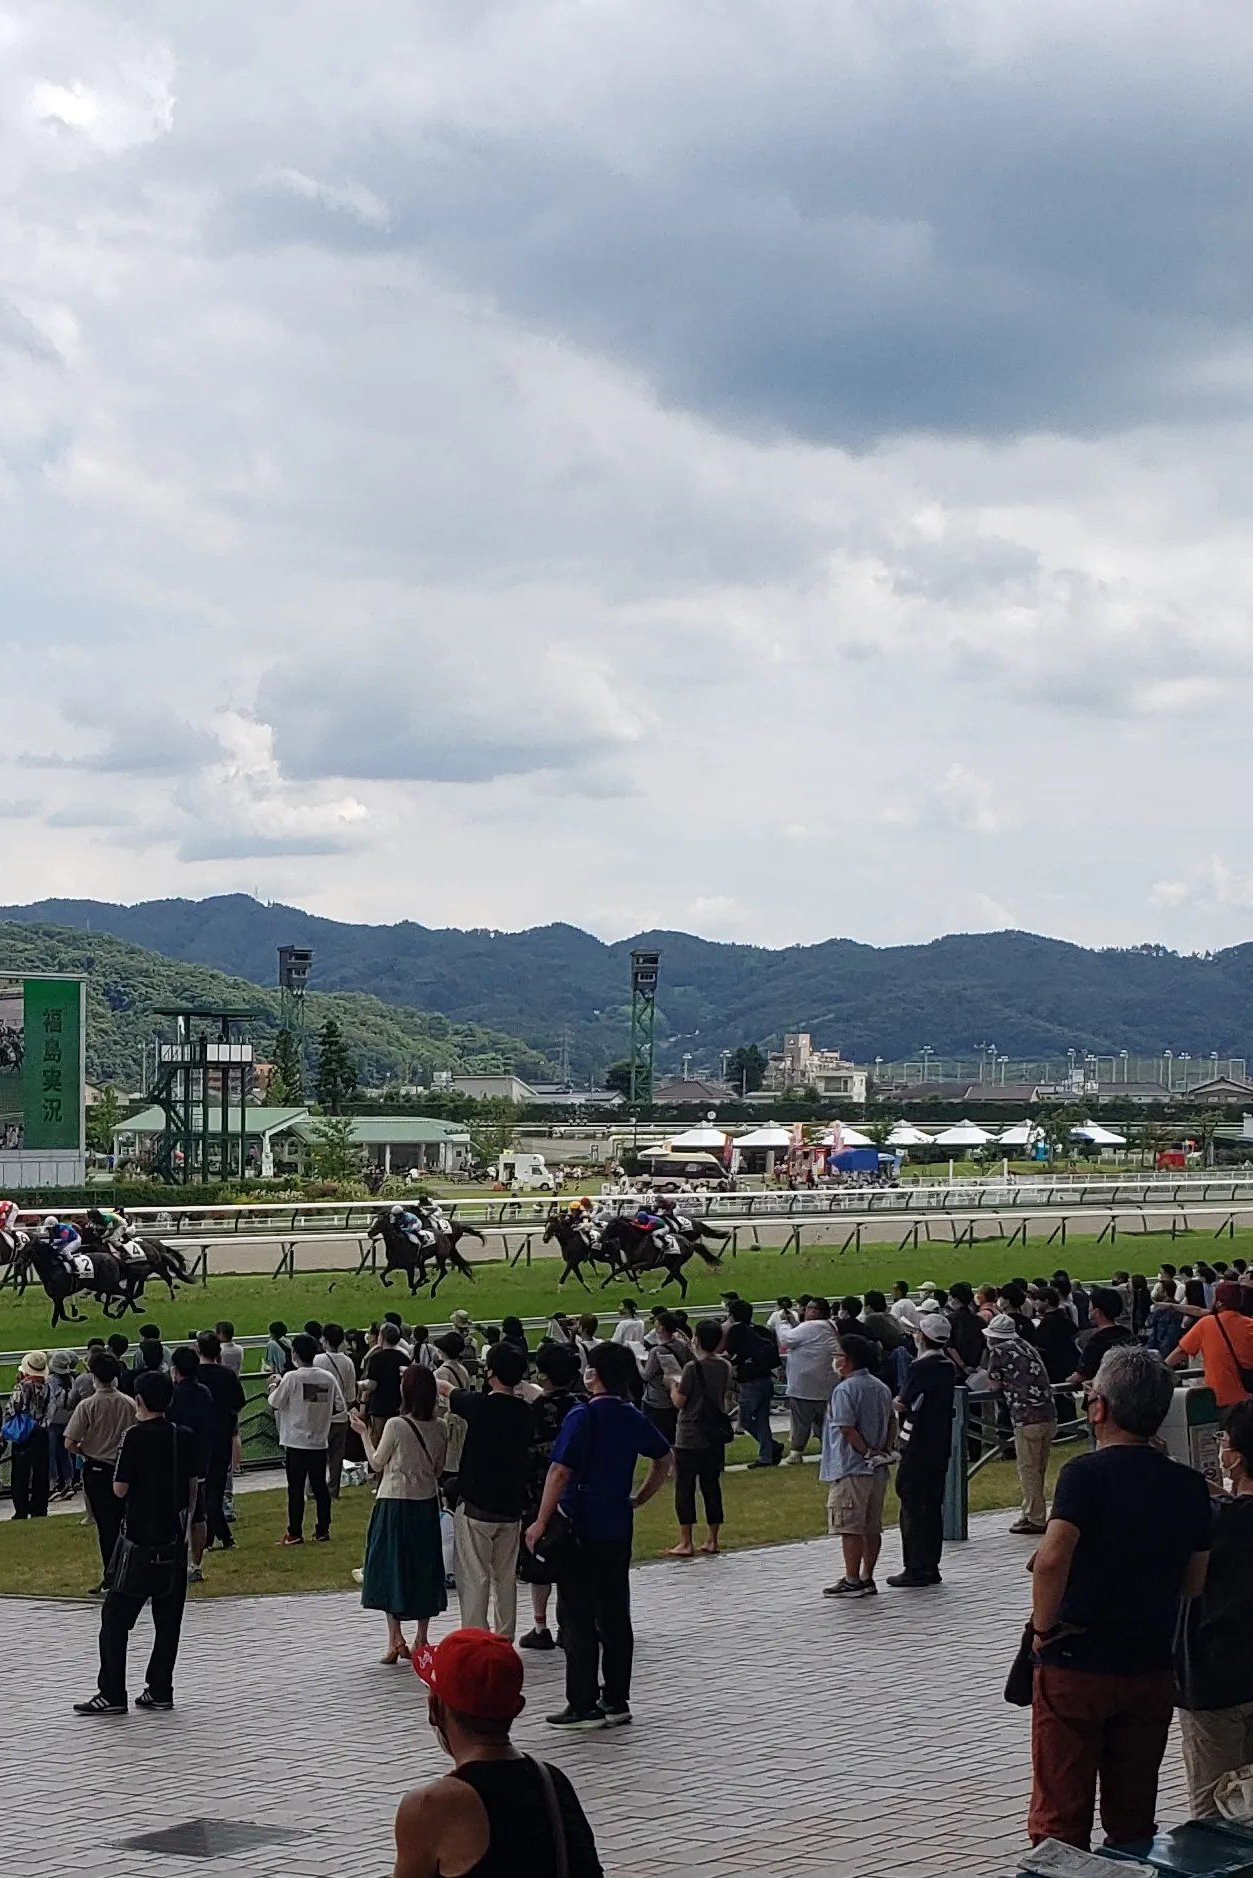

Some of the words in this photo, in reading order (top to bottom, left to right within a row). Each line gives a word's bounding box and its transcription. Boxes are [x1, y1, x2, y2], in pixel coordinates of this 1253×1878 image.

[43, 1007, 63, 1122] 福島実況
[132, 1244, 141, 1256] 4
[81, 1259, 92, 1272] 2
